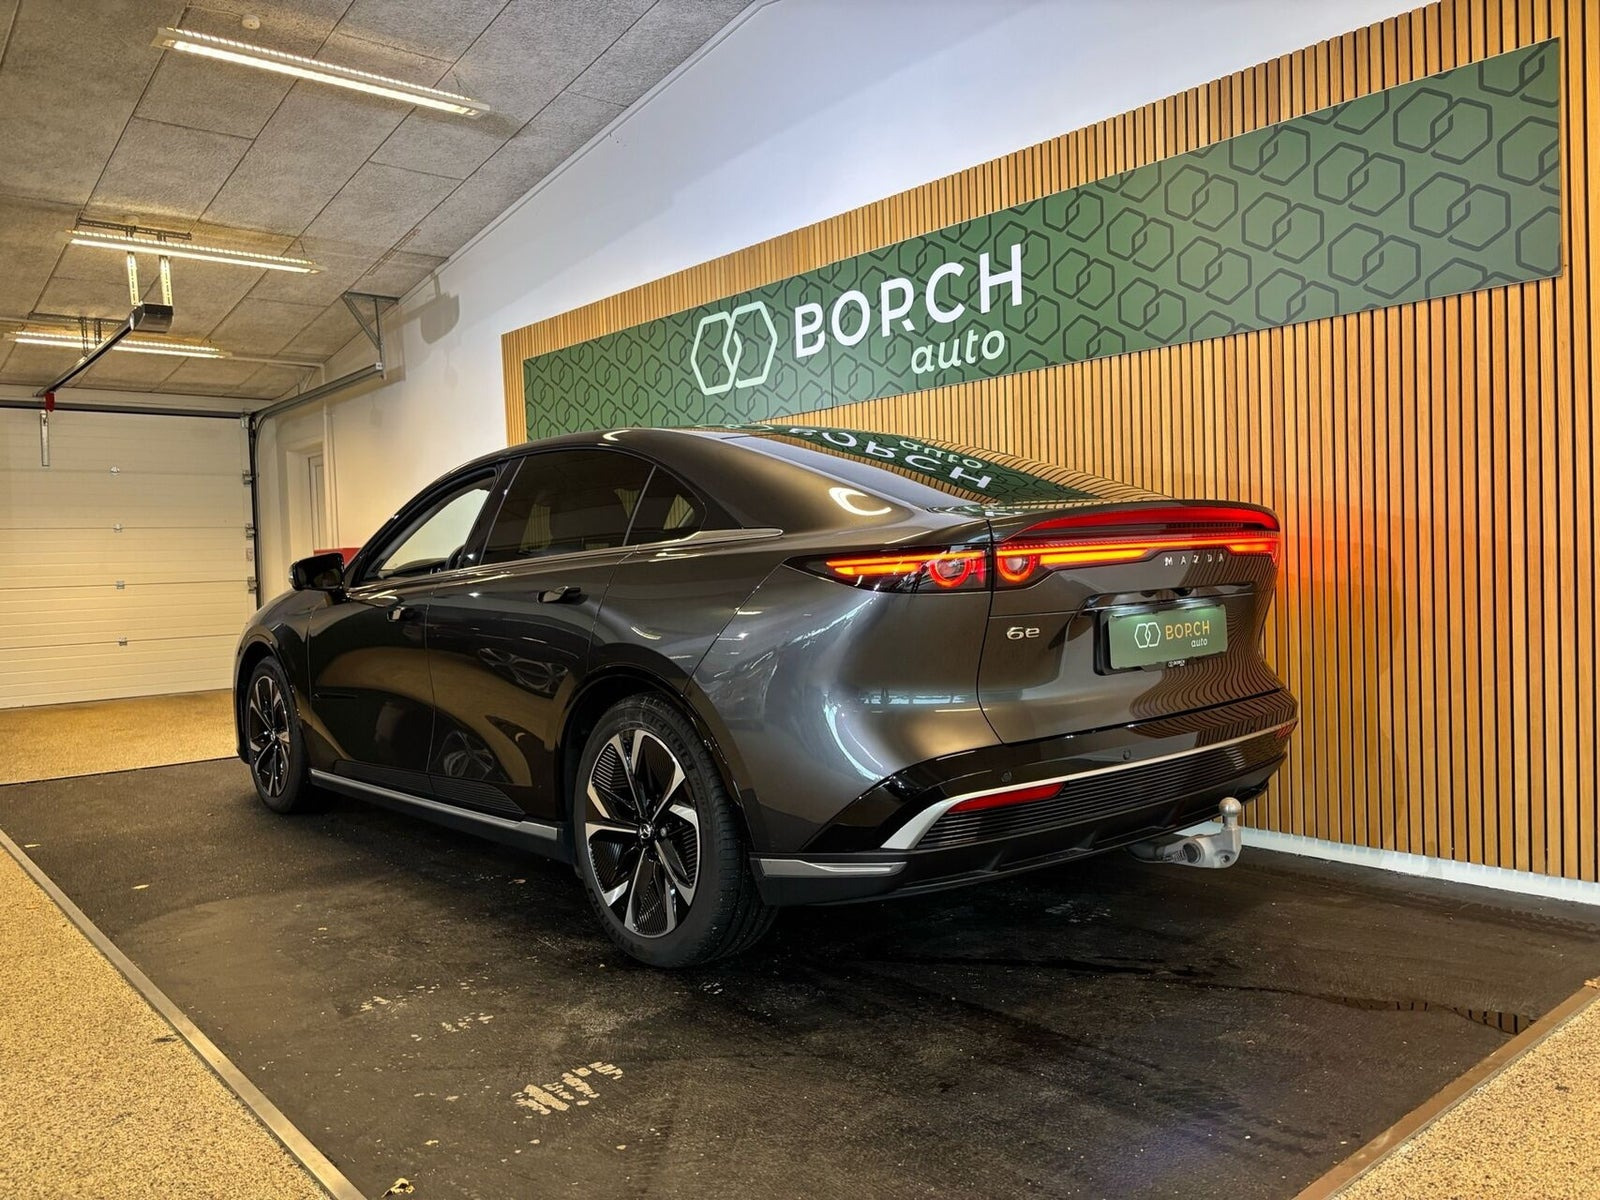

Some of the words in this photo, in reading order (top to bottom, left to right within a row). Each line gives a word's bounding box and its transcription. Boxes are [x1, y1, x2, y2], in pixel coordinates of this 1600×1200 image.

[795, 243, 1022, 358] BORCH
[911, 330, 1005, 374] auto
[1165, 553, 1224, 566] MAZDA
[1007, 626, 1040, 640] 6e
[1165, 620, 1210, 640] BORCH
[1191, 638, 1208, 648] auto
